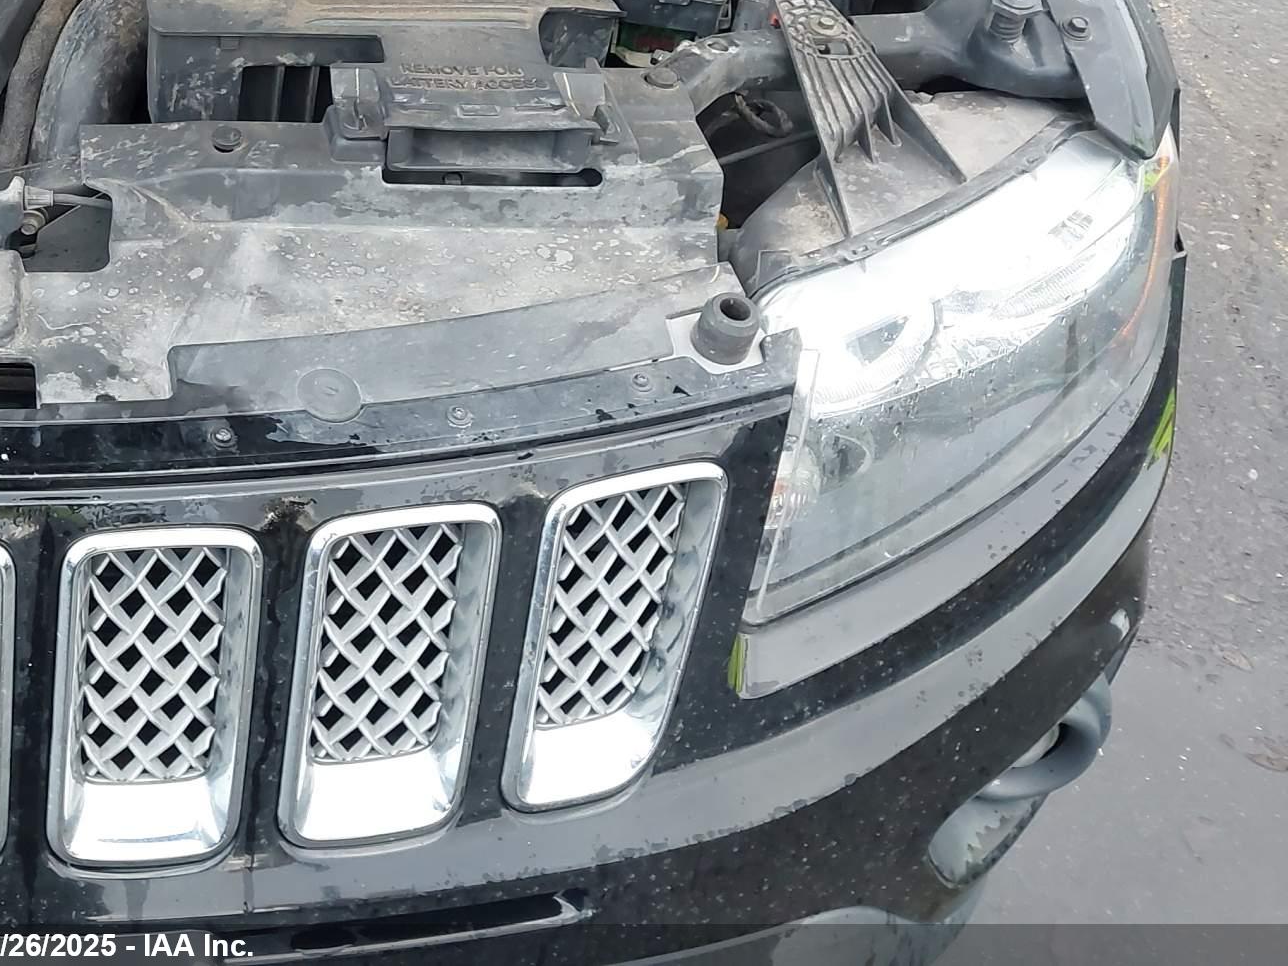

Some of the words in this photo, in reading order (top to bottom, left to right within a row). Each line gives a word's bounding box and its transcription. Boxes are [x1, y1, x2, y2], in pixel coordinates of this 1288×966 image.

[399, 63, 481, 76] REMOVE
[484, 65, 524, 78] FOR
[474, 78, 550, 91] ACCESS
